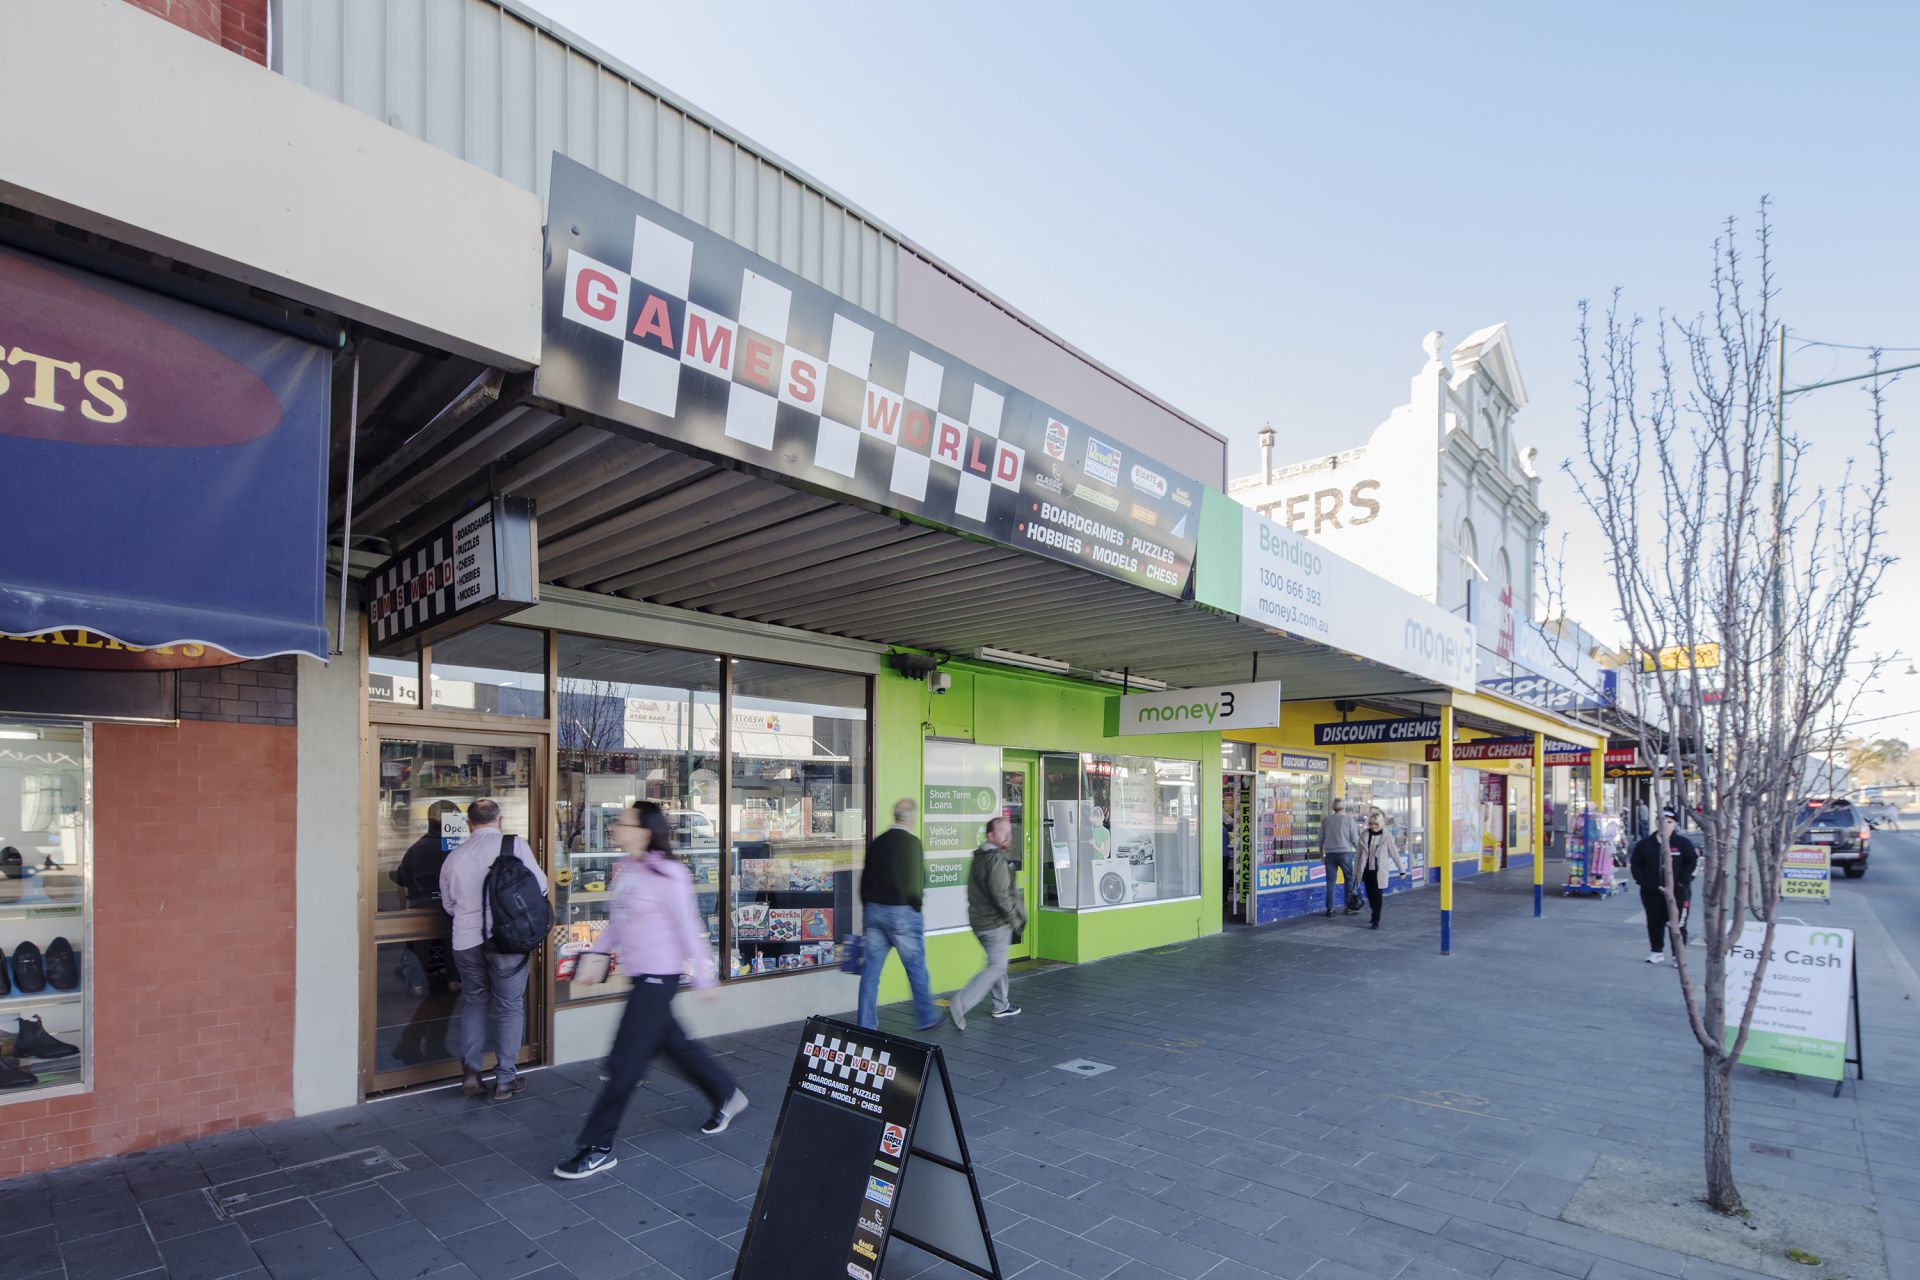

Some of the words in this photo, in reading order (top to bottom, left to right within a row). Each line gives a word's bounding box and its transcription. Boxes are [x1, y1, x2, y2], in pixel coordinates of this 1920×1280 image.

[575, 267, 817, 403] GAMES
[867, 390, 1018, 482] WORLD
[1046, 432, 1065, 447] AIRFIX
[1088, 442, 1113, 466] Revell
[1036, 473, 1063, 490] CLASSIC
[1135, 468, 1158, 485] BIANTE
[456, 511, 493, 541] BOARDGAMES
[1041, 502, 1125, 546] BOARDGAMES
[1131, 536, 1175, 565] PUZZLES
[457, 535, 480, 556] PUZZLES
[1027, 522, 1082, 555] HOBBIES
[1092, 545, 1138, 573] MODELS
[1146, 564, 1178, 587] CHESS
[1259, 522, 1322, 576] Bendigo
[458, 554, 475, 571] CHESS
[458, 567, 481, 585] HOBBIES
[459, 583, 481, 602] MODELS
[1260, 567, 1284, 592] 1300
[1286, 578, 1304, 601] 666
[1305, 586, 1321, 607] 393
[1259, 596, 1329, 634] money3.com.au
[1404, 617, 1473, 683] money3
[1138, 691, 1234, 724] money3
[1322, 724, 1386, 742] DISCOUNT
[1432, 745, 1485, 759] DCOUNT
[1487, 743, 1534, 757] CHEMIST
[1544, 752, 1582, 764] HEMIST
[1283, 756, 1308, 768] DISCOUNT
[1308, 758, 1328, 770] CHEMIST
[929, 790, 951, 799] Short
[952, 791, 971, 799] Term
[929, 801, 952, 809] Loans
[930, 826, 957, 836] Vehicle
[929, 837, 959, 846] Finance
[929, 863, 962, 873] Cheques
[1268, 867, 1291, 886] 85%
[1291, 866, 1309, 882] OFF
[929, 873, 958, 883] Cashed
[1787, 880, 1823, 888] NOW
[1786, 887, 1825, 895] OPEN
[1784, 950, 1841, 969] Cash
[805, 1045, 844, 1063] GAMES
[851, 1056, 894, 1077] WORLD
[808, 1073, 849, 1092] BOARDGAMES
[852, 1087, 880, 1102] PUZZLES
[801, 1081, 827, 1095] HOBBIES
[830, 1091, 857, 1105] MODELS
[861, 1100, 883, 1114] CHESS
[884, 1134, 903, 1146] AIRFIX
[859, 1217, 885, 1234] CLASSIC
